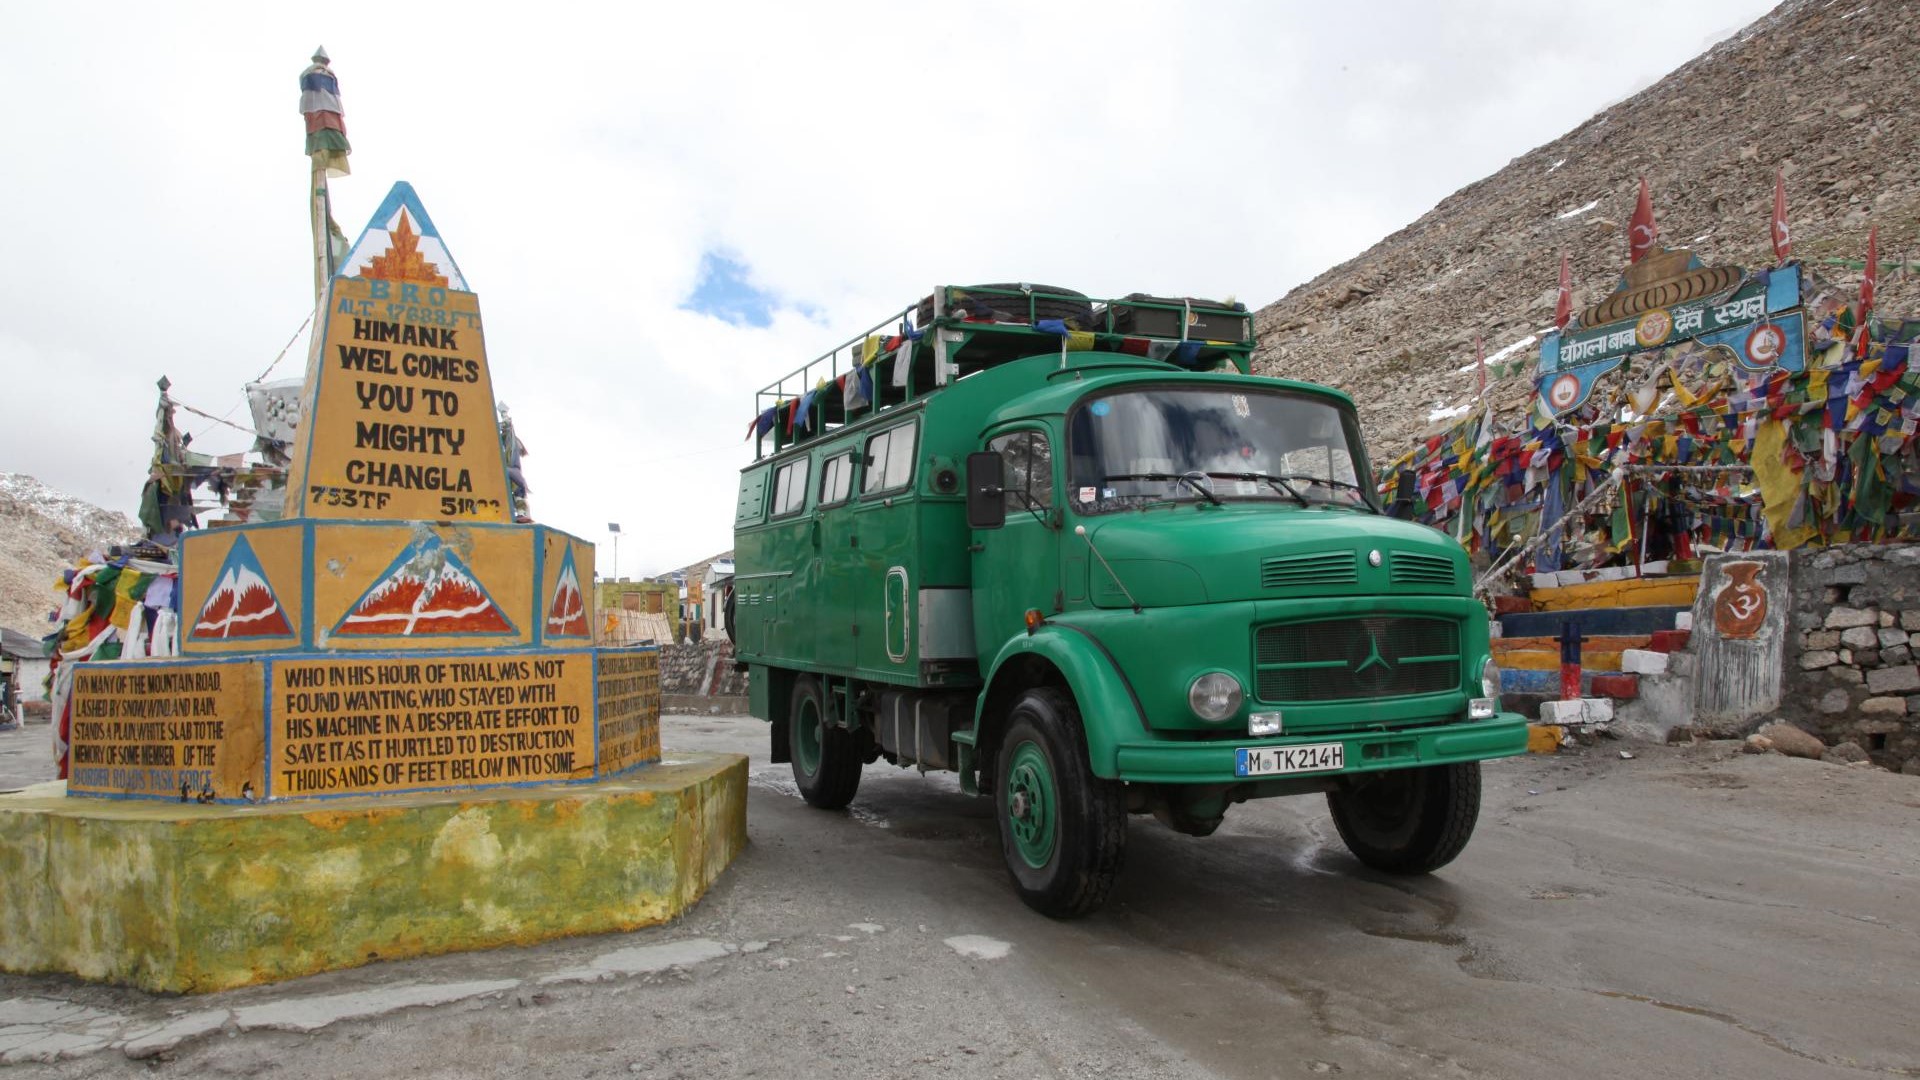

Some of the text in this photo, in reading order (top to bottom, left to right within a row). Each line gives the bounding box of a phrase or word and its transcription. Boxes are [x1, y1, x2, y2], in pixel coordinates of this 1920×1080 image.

[369, 279, 447, 306] BRO
[353, 318, 459, 350] HIMANK
[1608, 328, 1636, 350] बाबा
[337, 344, 480, 383] WELCOMES
[356, 381, 459, 416] YOU TO
[355, 421, 465, 455] MIGHTY
[346, 460, 472, 492] CHANGLA
[77, 676, 89, 693] ON
[91, 676, 115, 693] MANY
[116, 675, 127, 693] OF
[129, 675, 146, 694] THE
[148, 674, 194, 693] MOUNTAIN
[285, 667, 324, 687] WHO
[330, 667, 344, 686] IN
[348, 666, 375, 685] HIS
[378, 665, 421, 685] HOUR
[426, 665, 446, 683] OF
[497, 662, 530, 680] WAS
[534, 660, 565, 678] NOT
[76, 700, 108, 717] LASHED
[110, 700, 121, 717] BY
[172, 698, 190, 716] AND
[286, 692, 339, 713] FOUND
[417, 688, 455, 708] WHO
[459, 686, 514, 706] STAYED
[518, 684, 555, 703] WITH
[75, 723, 105, 740] STANDS
[107, 725, 112, 740] A
[138, 722, 165, 740] WHITE
[168, 722, 191, 740] SLAB
[193, 722, 205, 740] TO
[207, 721, 224, 739] THE
[286, 719, 313, 739] HIS
[316, 715, 381, 737] MACHINE
[386, 715, 399, 733] IN
[403, 714, 414, 732] A
[418, 710, 501, 732] DESPERATE
[506, 708, 558, 728] EFFORT
[561, 706, 579, 724] TO
[75, 745, 216, 766] MEMORY OF SOME MEMBER OF THE
[285, 729, 574, 765] SAVE IT AS IT HURTLED TO DESTRUCTION
[1249, 752, 1260, 771] M
[282, 765, 378, 791] THOUSANDS
[384, 763, 404, 784] OF
[408, 761, 447, 783] FEET
[452, 757, 503, 779] BELOW
